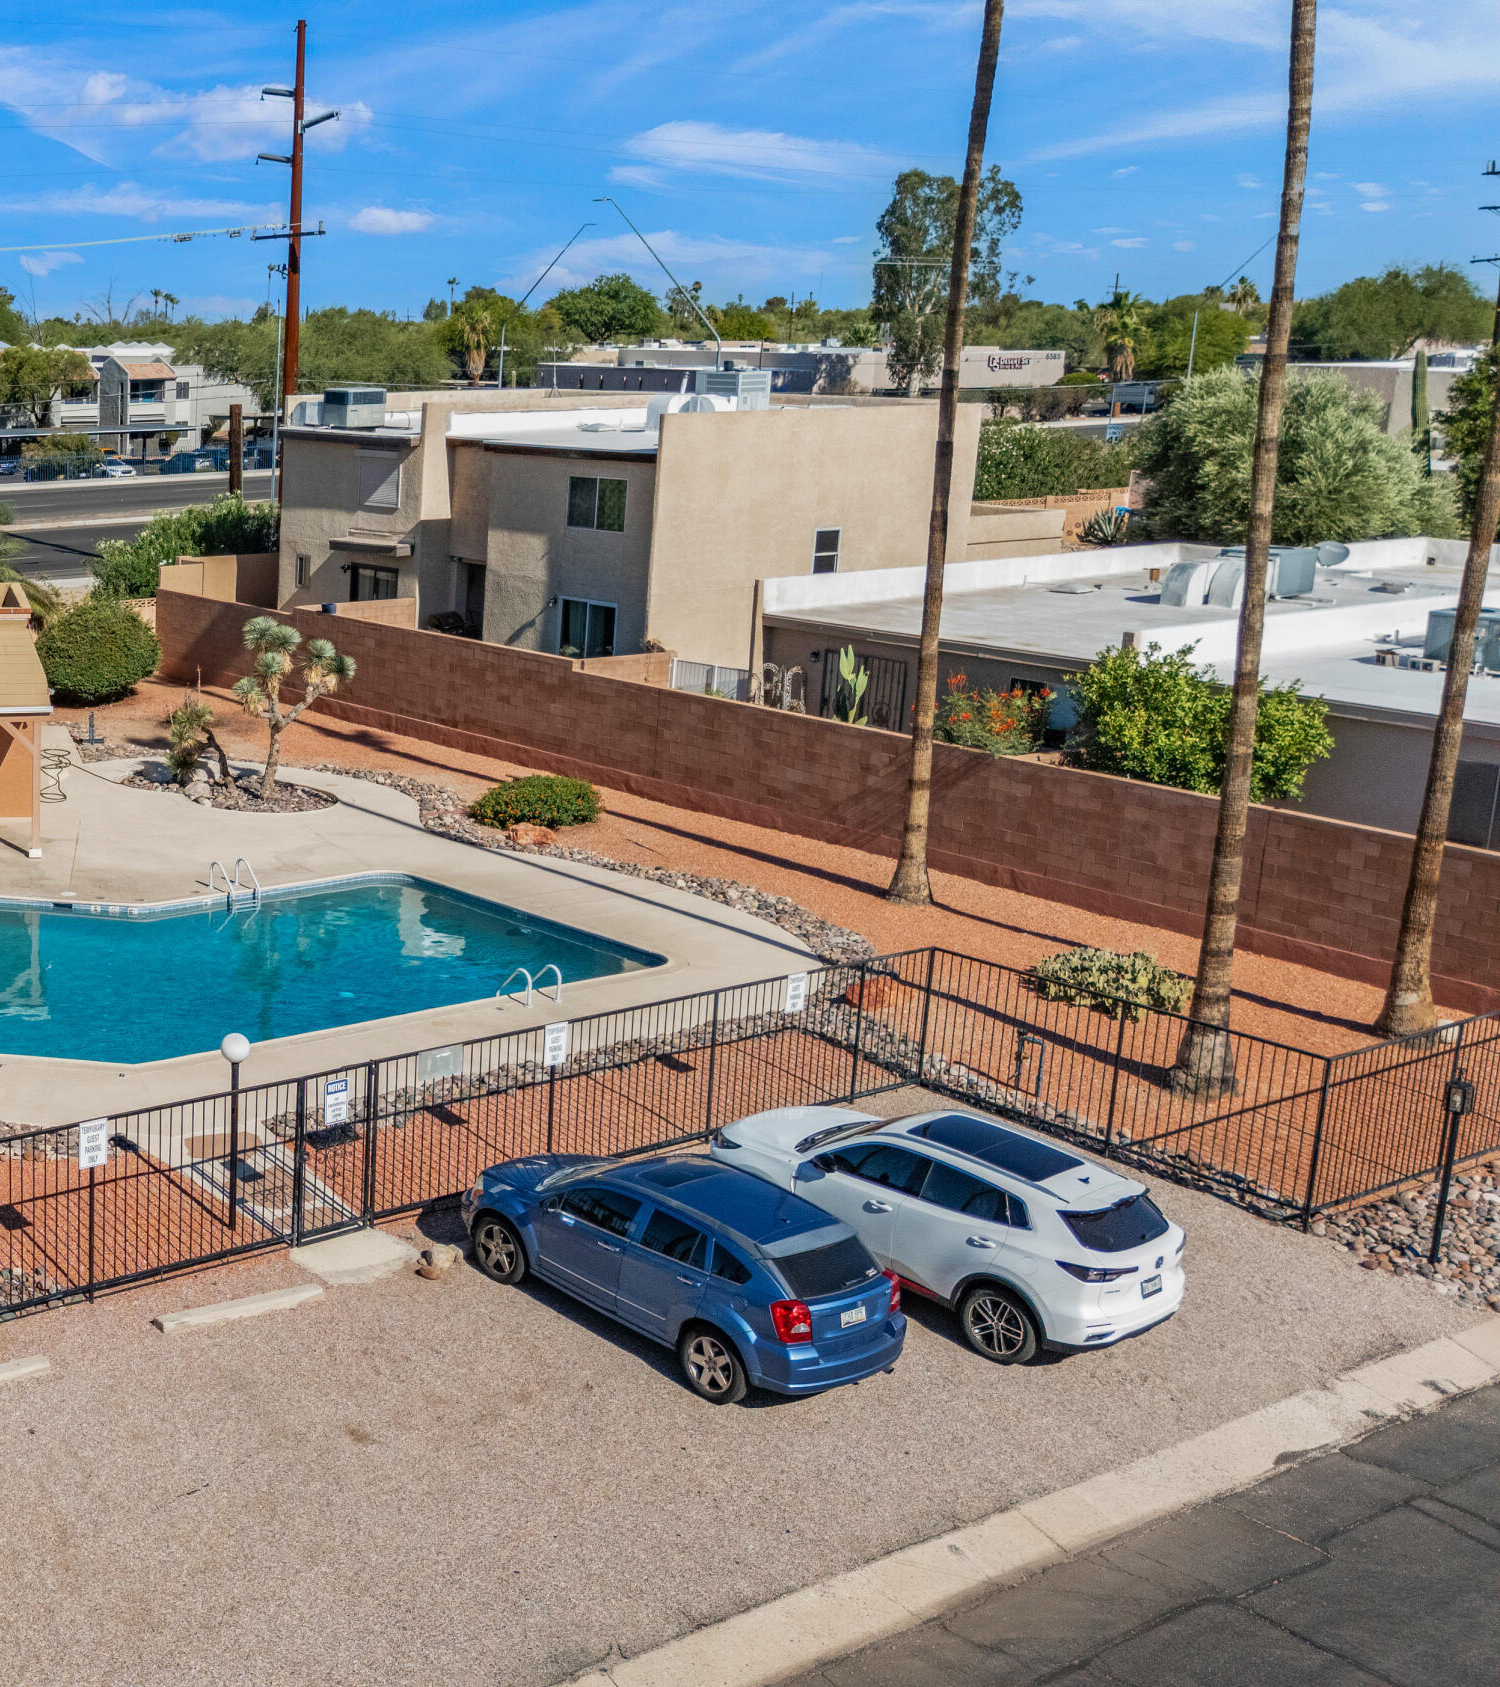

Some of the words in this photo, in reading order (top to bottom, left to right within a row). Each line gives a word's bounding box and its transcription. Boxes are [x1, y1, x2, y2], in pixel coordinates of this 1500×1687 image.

[327, 1080, 347, 1093] NOTICE
[81, 1123, 105, 1134] TEMPORARY
[86, 1134, 100, 1144] GUEST
[84, 1143, 102, 1154] PARKING
[88, 1154, 98, 1163] ONLY
